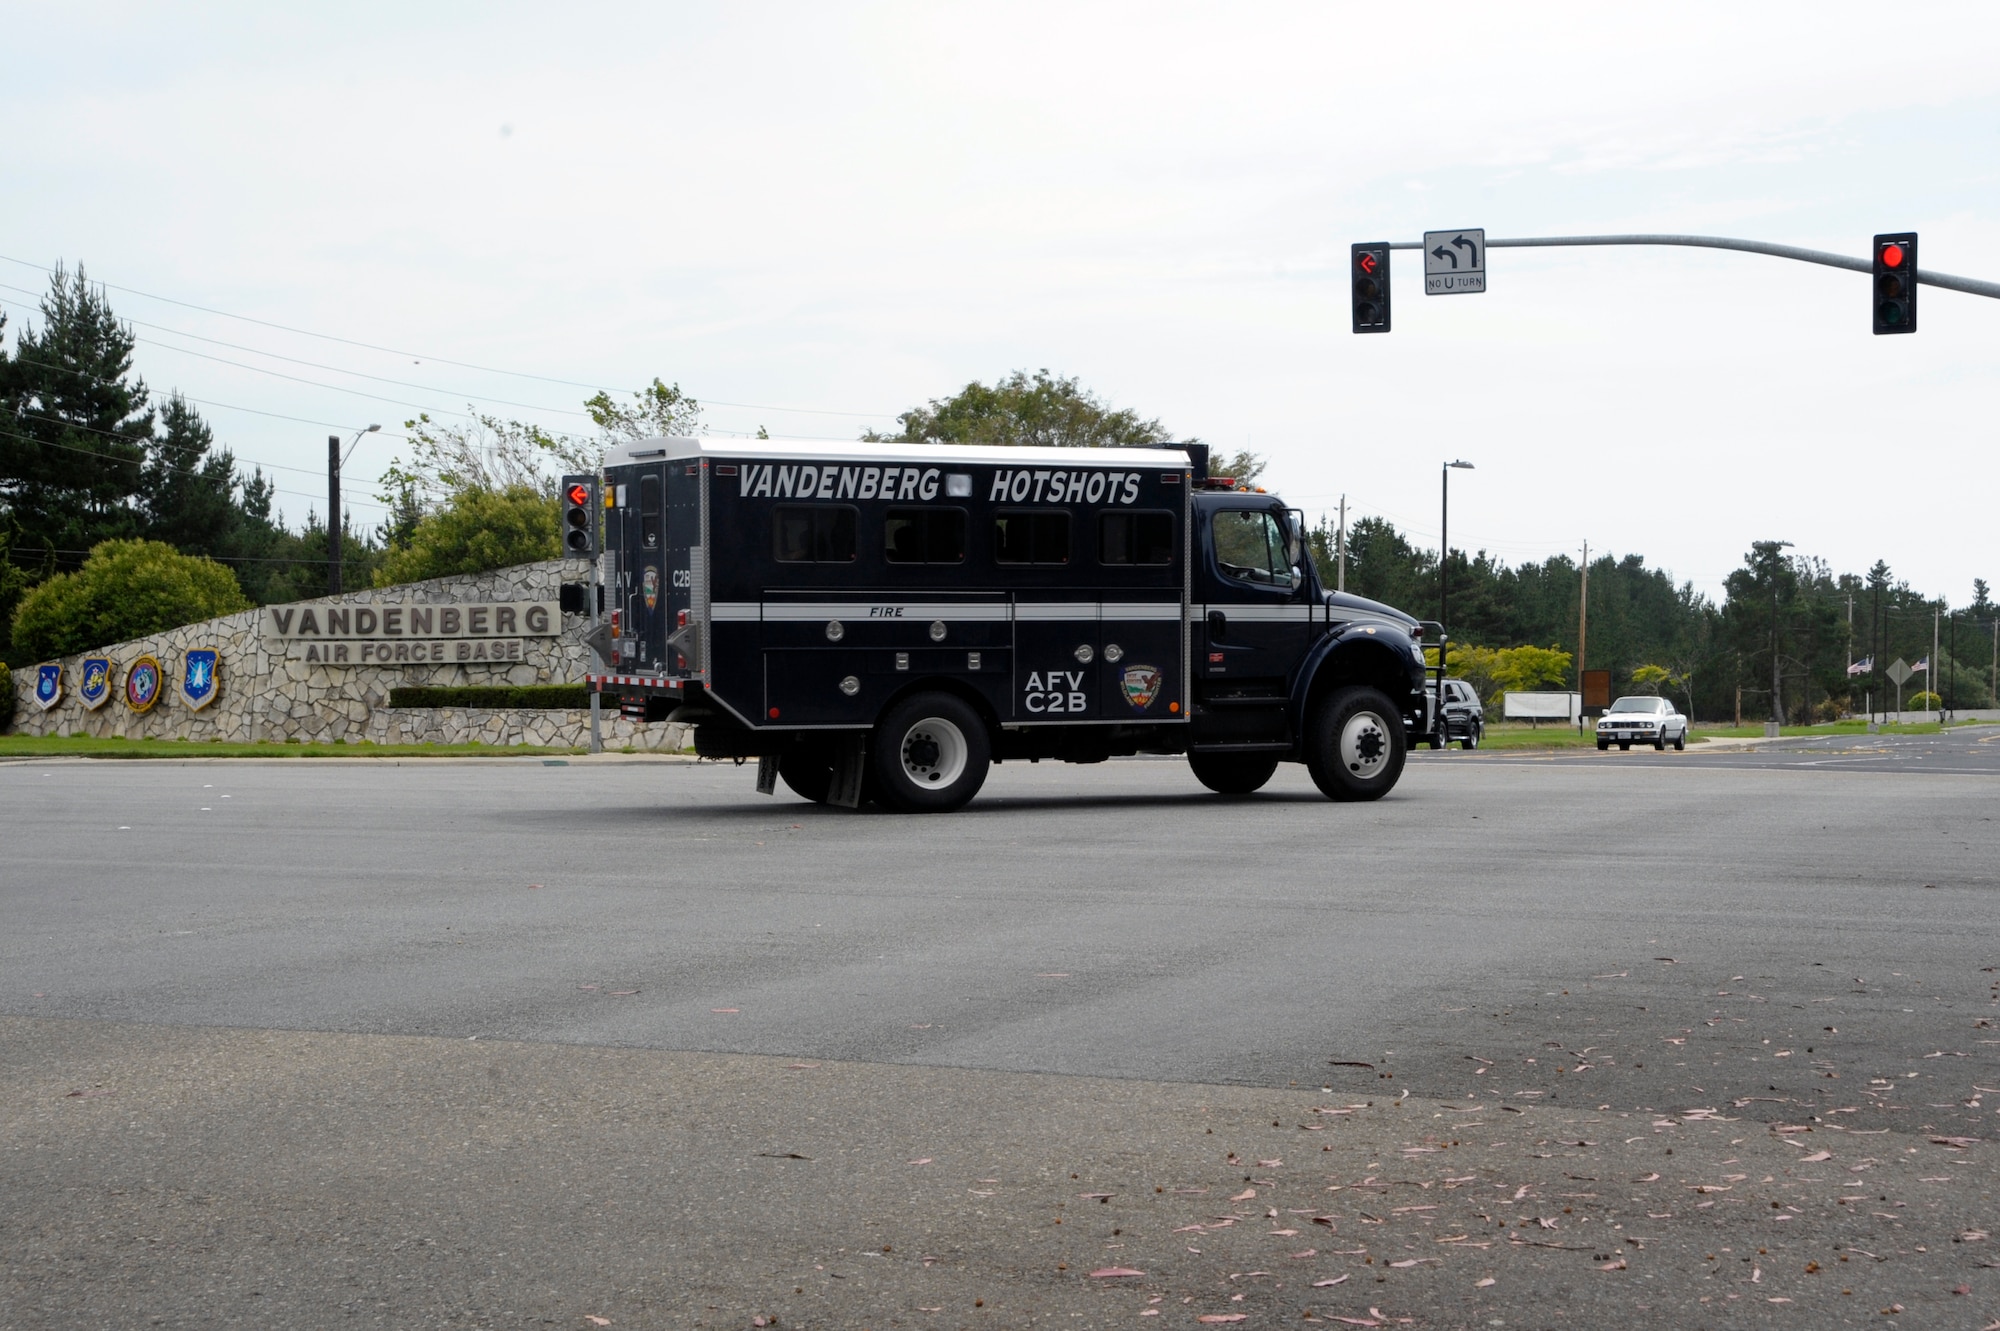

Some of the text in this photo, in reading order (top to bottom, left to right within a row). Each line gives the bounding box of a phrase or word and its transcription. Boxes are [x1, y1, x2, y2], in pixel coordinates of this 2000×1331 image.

[1429, 277, 1482, 289] NO U TURN
[739, 464, 1142, 504] VANDENBERG HOTSHOTS
[615, 571, 632, 588] AV
[672, 569, 691, 588] C2B
[271, 605, 549, 635] VANDENBERG
[870, 607, 904, 618] FIRE
[305, 640, 520, 663] AIR FORCE BASE
[1024, 671, 1085, 692] AFV
[1025, 691, 1087, 713] C2B
